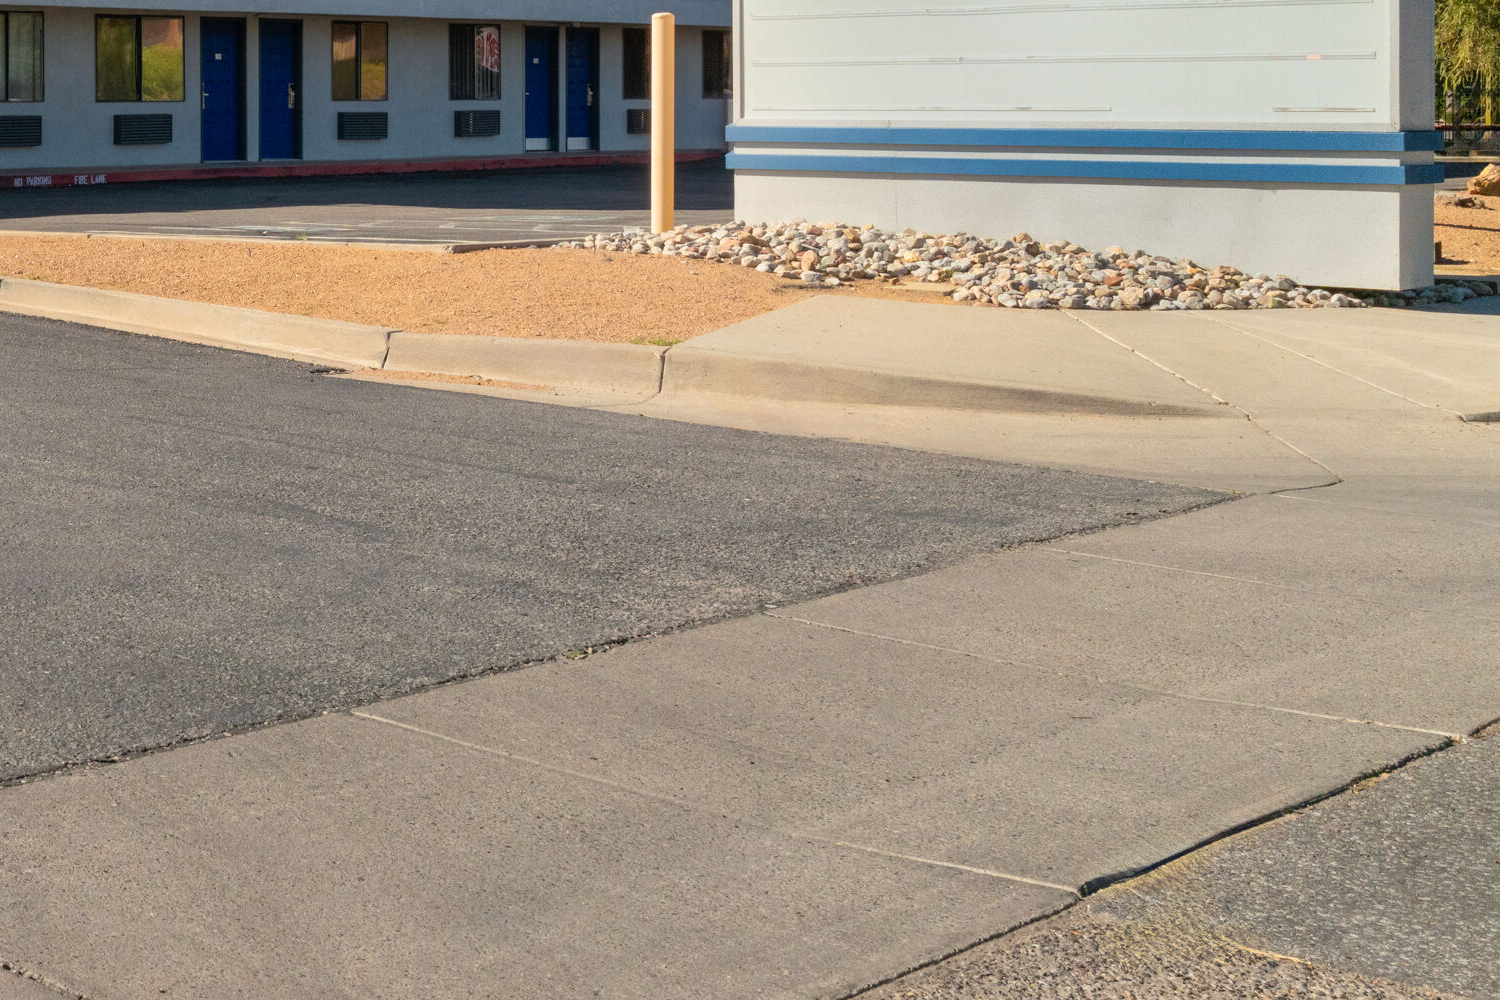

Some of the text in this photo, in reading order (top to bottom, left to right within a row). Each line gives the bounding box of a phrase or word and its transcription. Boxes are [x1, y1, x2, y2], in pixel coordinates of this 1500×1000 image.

[13, 174, 107, 188] NO PARKING FIRE LANE
